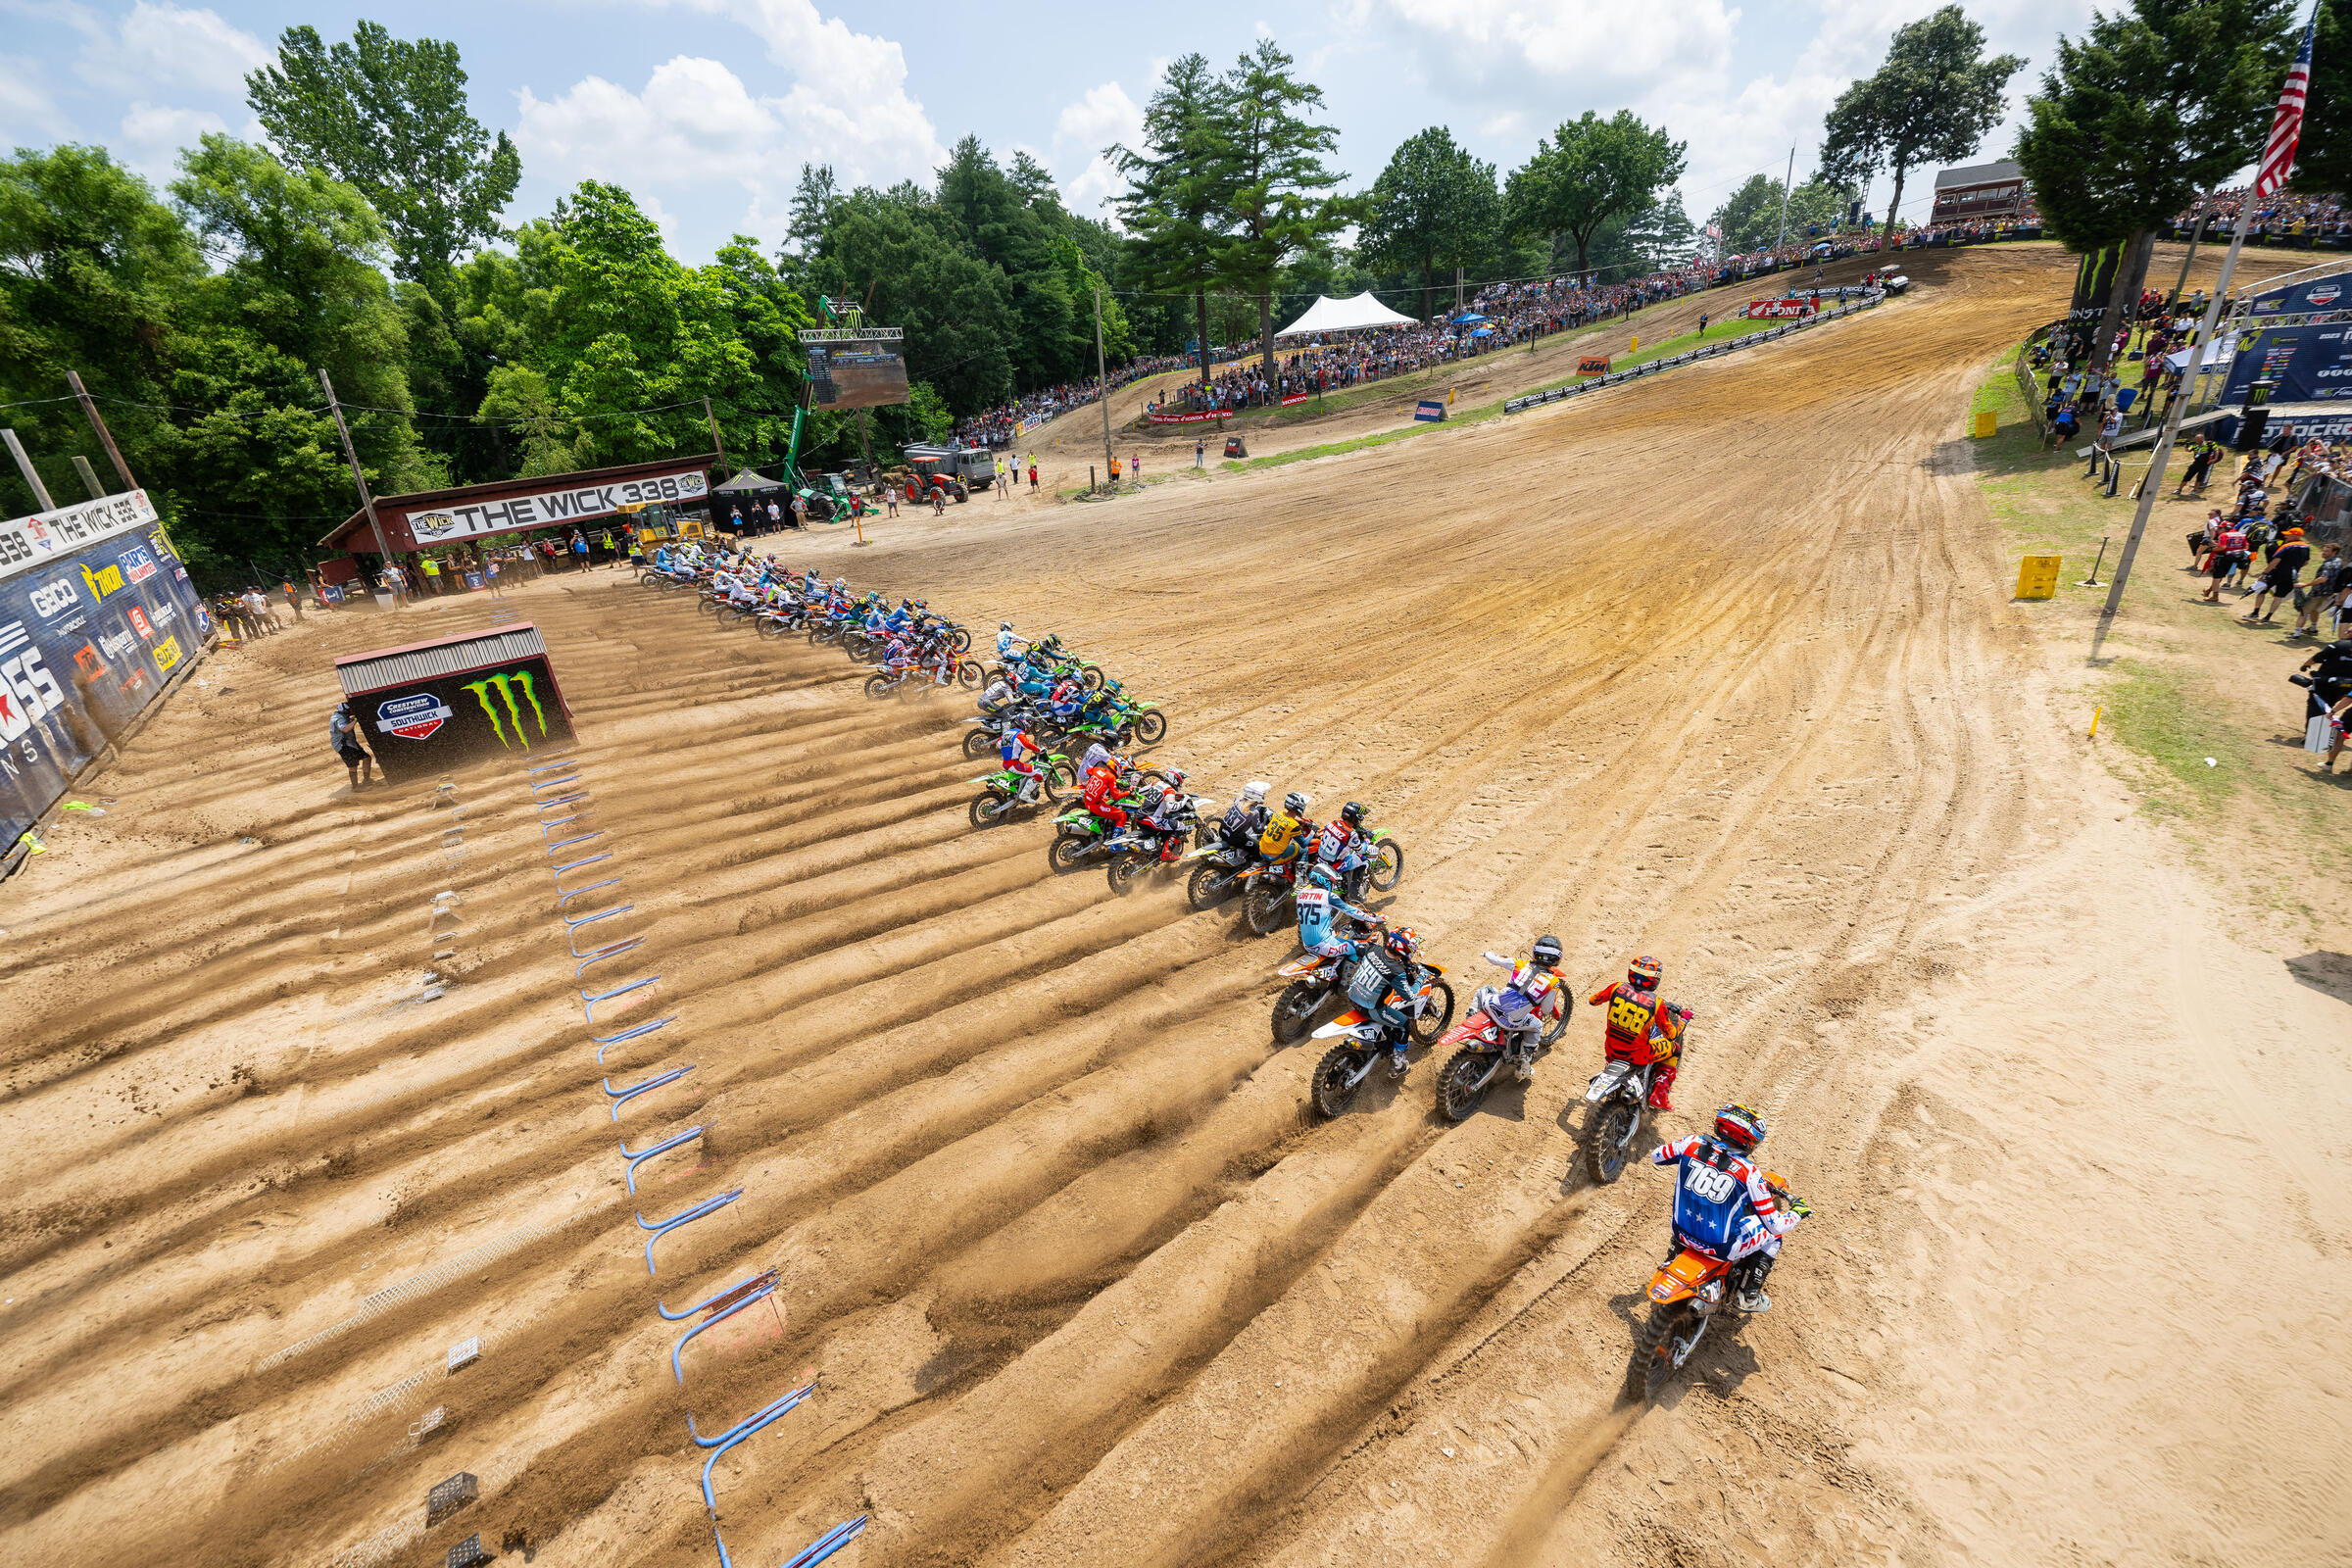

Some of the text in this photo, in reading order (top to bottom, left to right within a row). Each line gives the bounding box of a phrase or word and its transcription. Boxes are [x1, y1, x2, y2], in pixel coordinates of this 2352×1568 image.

[1765, 305, 1816, 316] HONA
[1578, 361, 1606, 371] KTM
[1282, 396, 1307, 406] HONDA
[453, 481, 679, 532] THE WICK 338
[49, 514, 87, 544] THE
[81, 505, 120, 534] WICK
[113, 500, 139, 523] 338
[412, 515, 455, 530] THE WICK
[120, 546, 150, 572] PARTS
[93, 564, 126, 597] THOR
[29, 578, 79, 618] GEICO
[387, 697, 429, 711] CRESTVIEW
[390, 710, 438, 728] SOUTHWICK
[398, 720, 438, 733] NATIONAL
[1298, 892, 1323, 901] ORTIN
[1297, 903, 1322, 926] 375
[1327, 943, 1348, 956] FXR
[1607, 996, 1650, 1034] 268
[1684, 1158, 1736, 1204] 769
